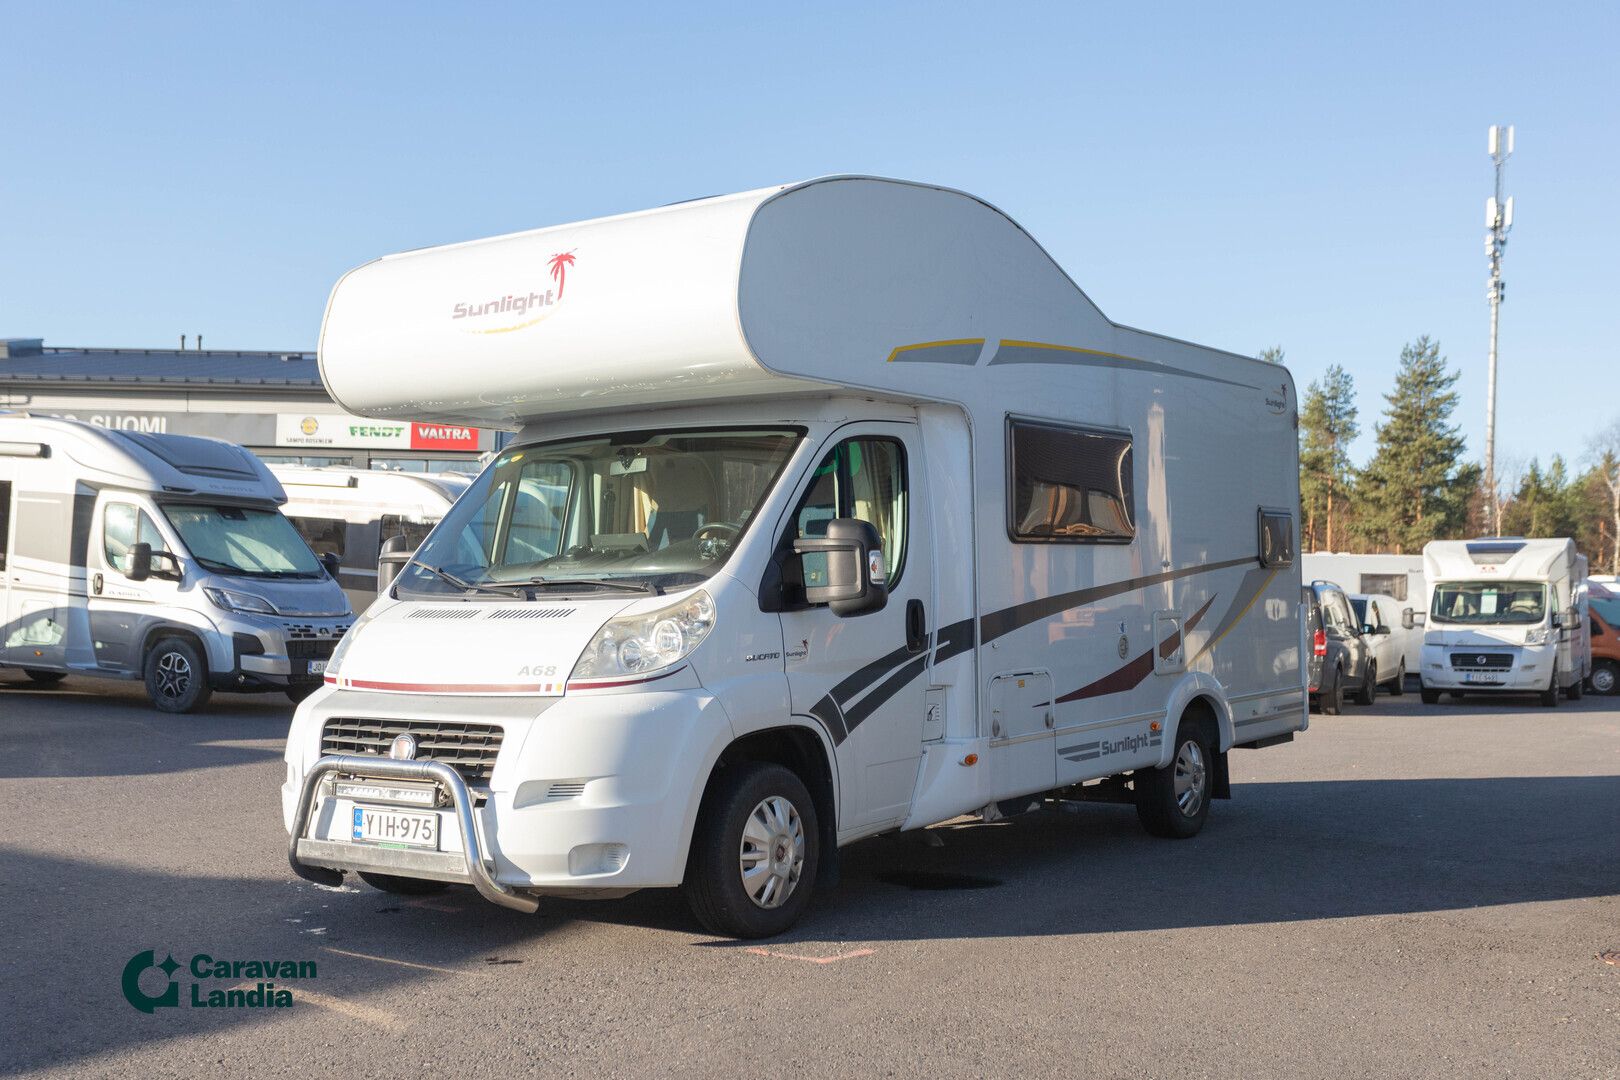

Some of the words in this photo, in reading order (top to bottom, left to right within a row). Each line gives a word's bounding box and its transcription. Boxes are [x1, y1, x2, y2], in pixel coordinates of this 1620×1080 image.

[452, 289, 554, 320] Sunlight
[90, 414, 167, 434] SUOMI
[349, 426, 405, 438] FENDT
[418, 426, 472, 441] VALTRA
[785, 650, 807, 658] Sunlight
[517, 665, 557, 677] A68
[1101, 733, 1149, 755] Sunlight
[366, 814, 433, 841] YIH-975
